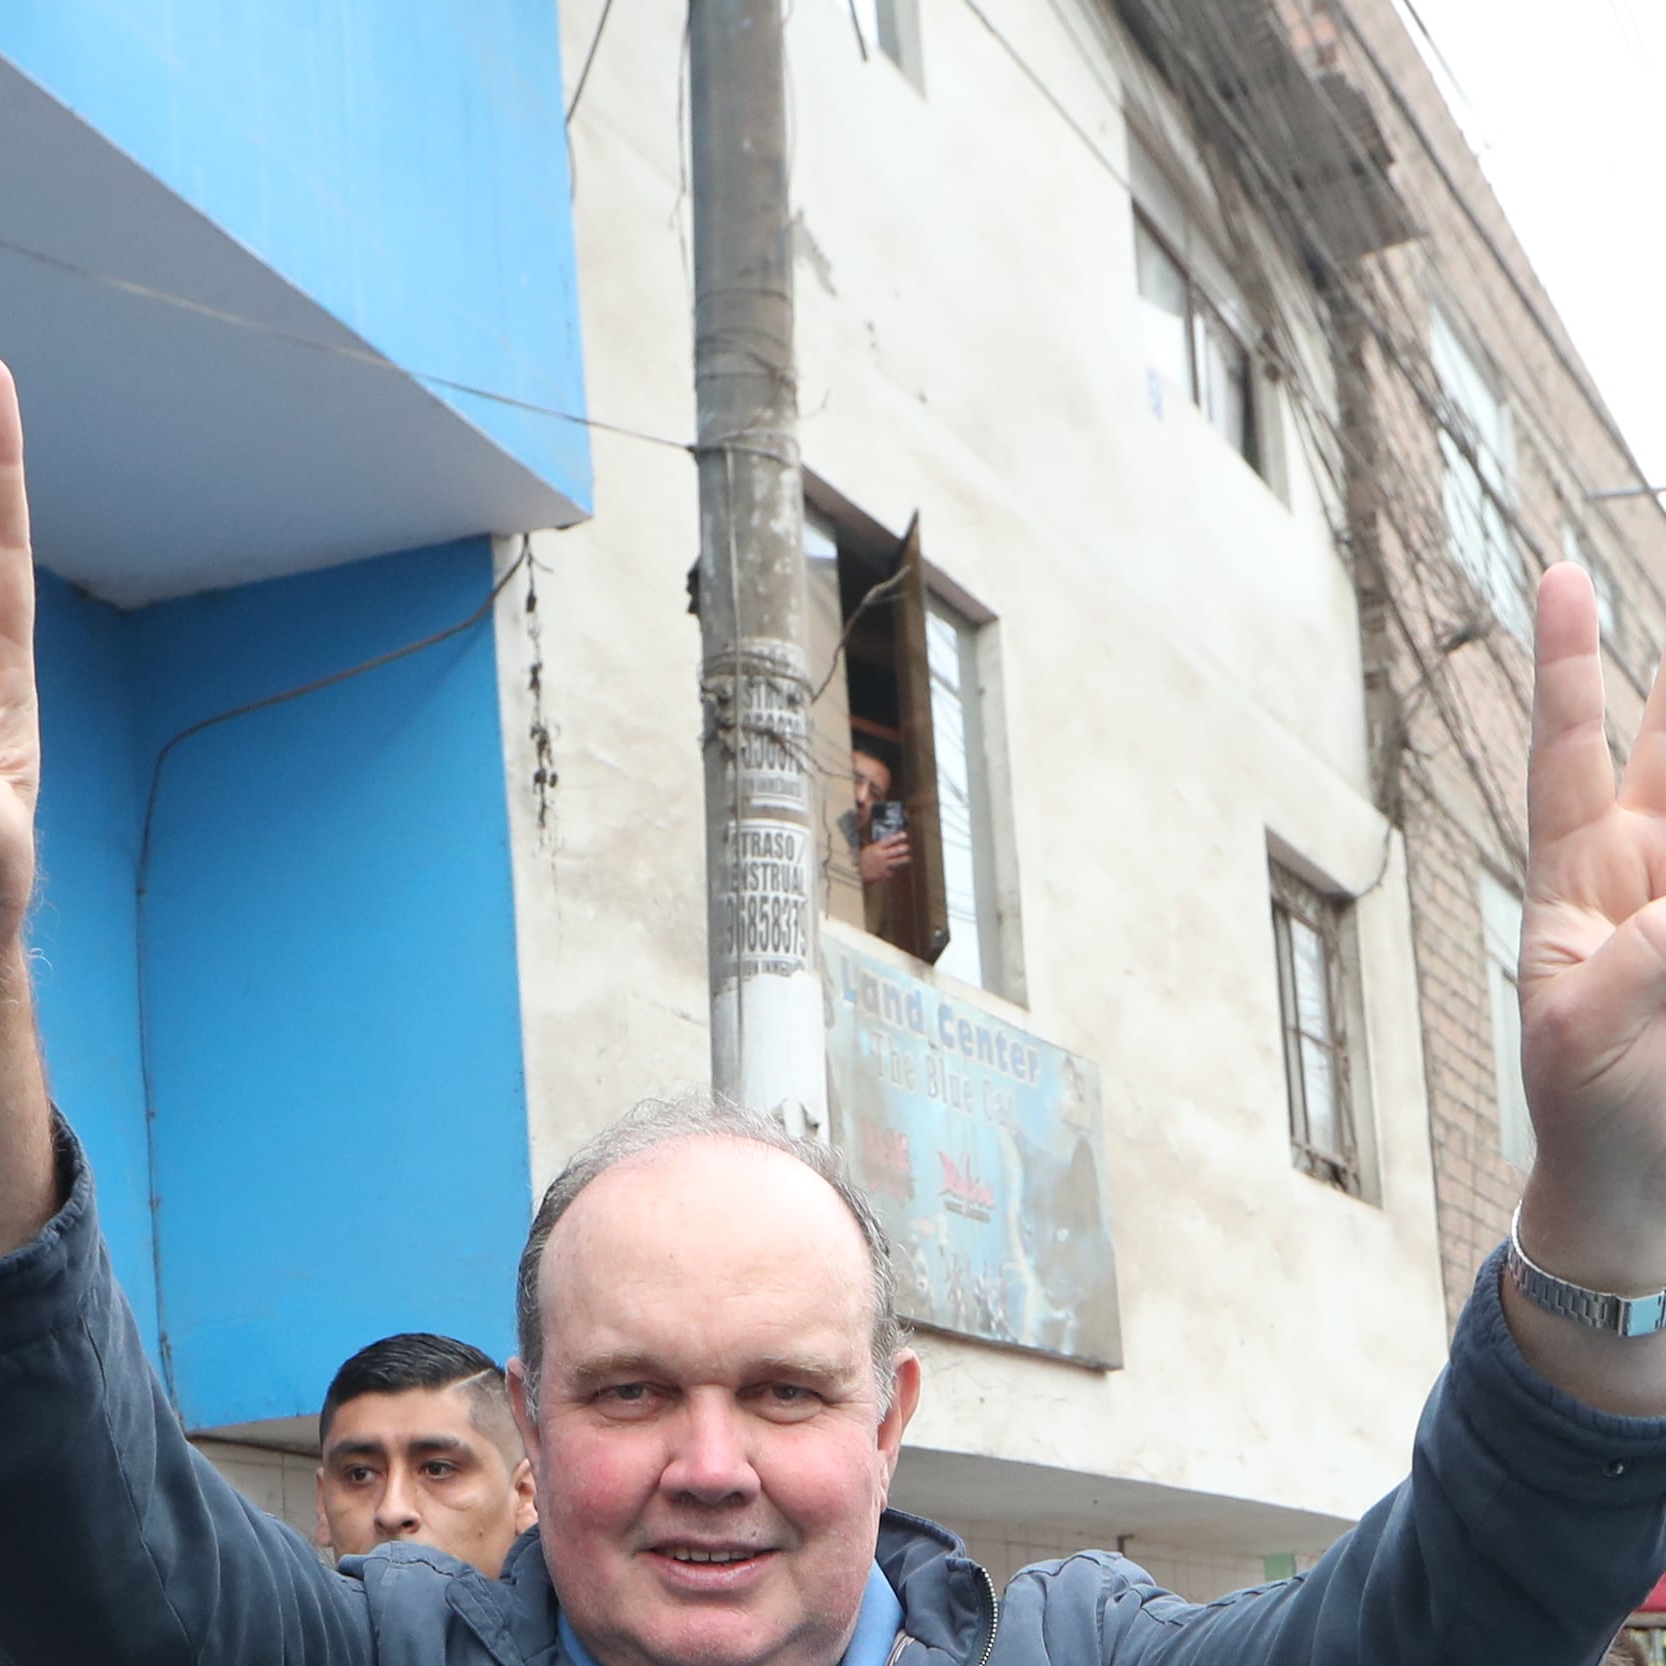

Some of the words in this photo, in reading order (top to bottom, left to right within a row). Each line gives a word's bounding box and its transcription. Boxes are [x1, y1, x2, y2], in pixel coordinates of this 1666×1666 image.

[729, 860, 806, 896] ENSTRUAL
[840, 955, 925, 1034] Land
[937, 1001, 1039, 1084] Center
[924, 1052, 974, 1114] Blue
